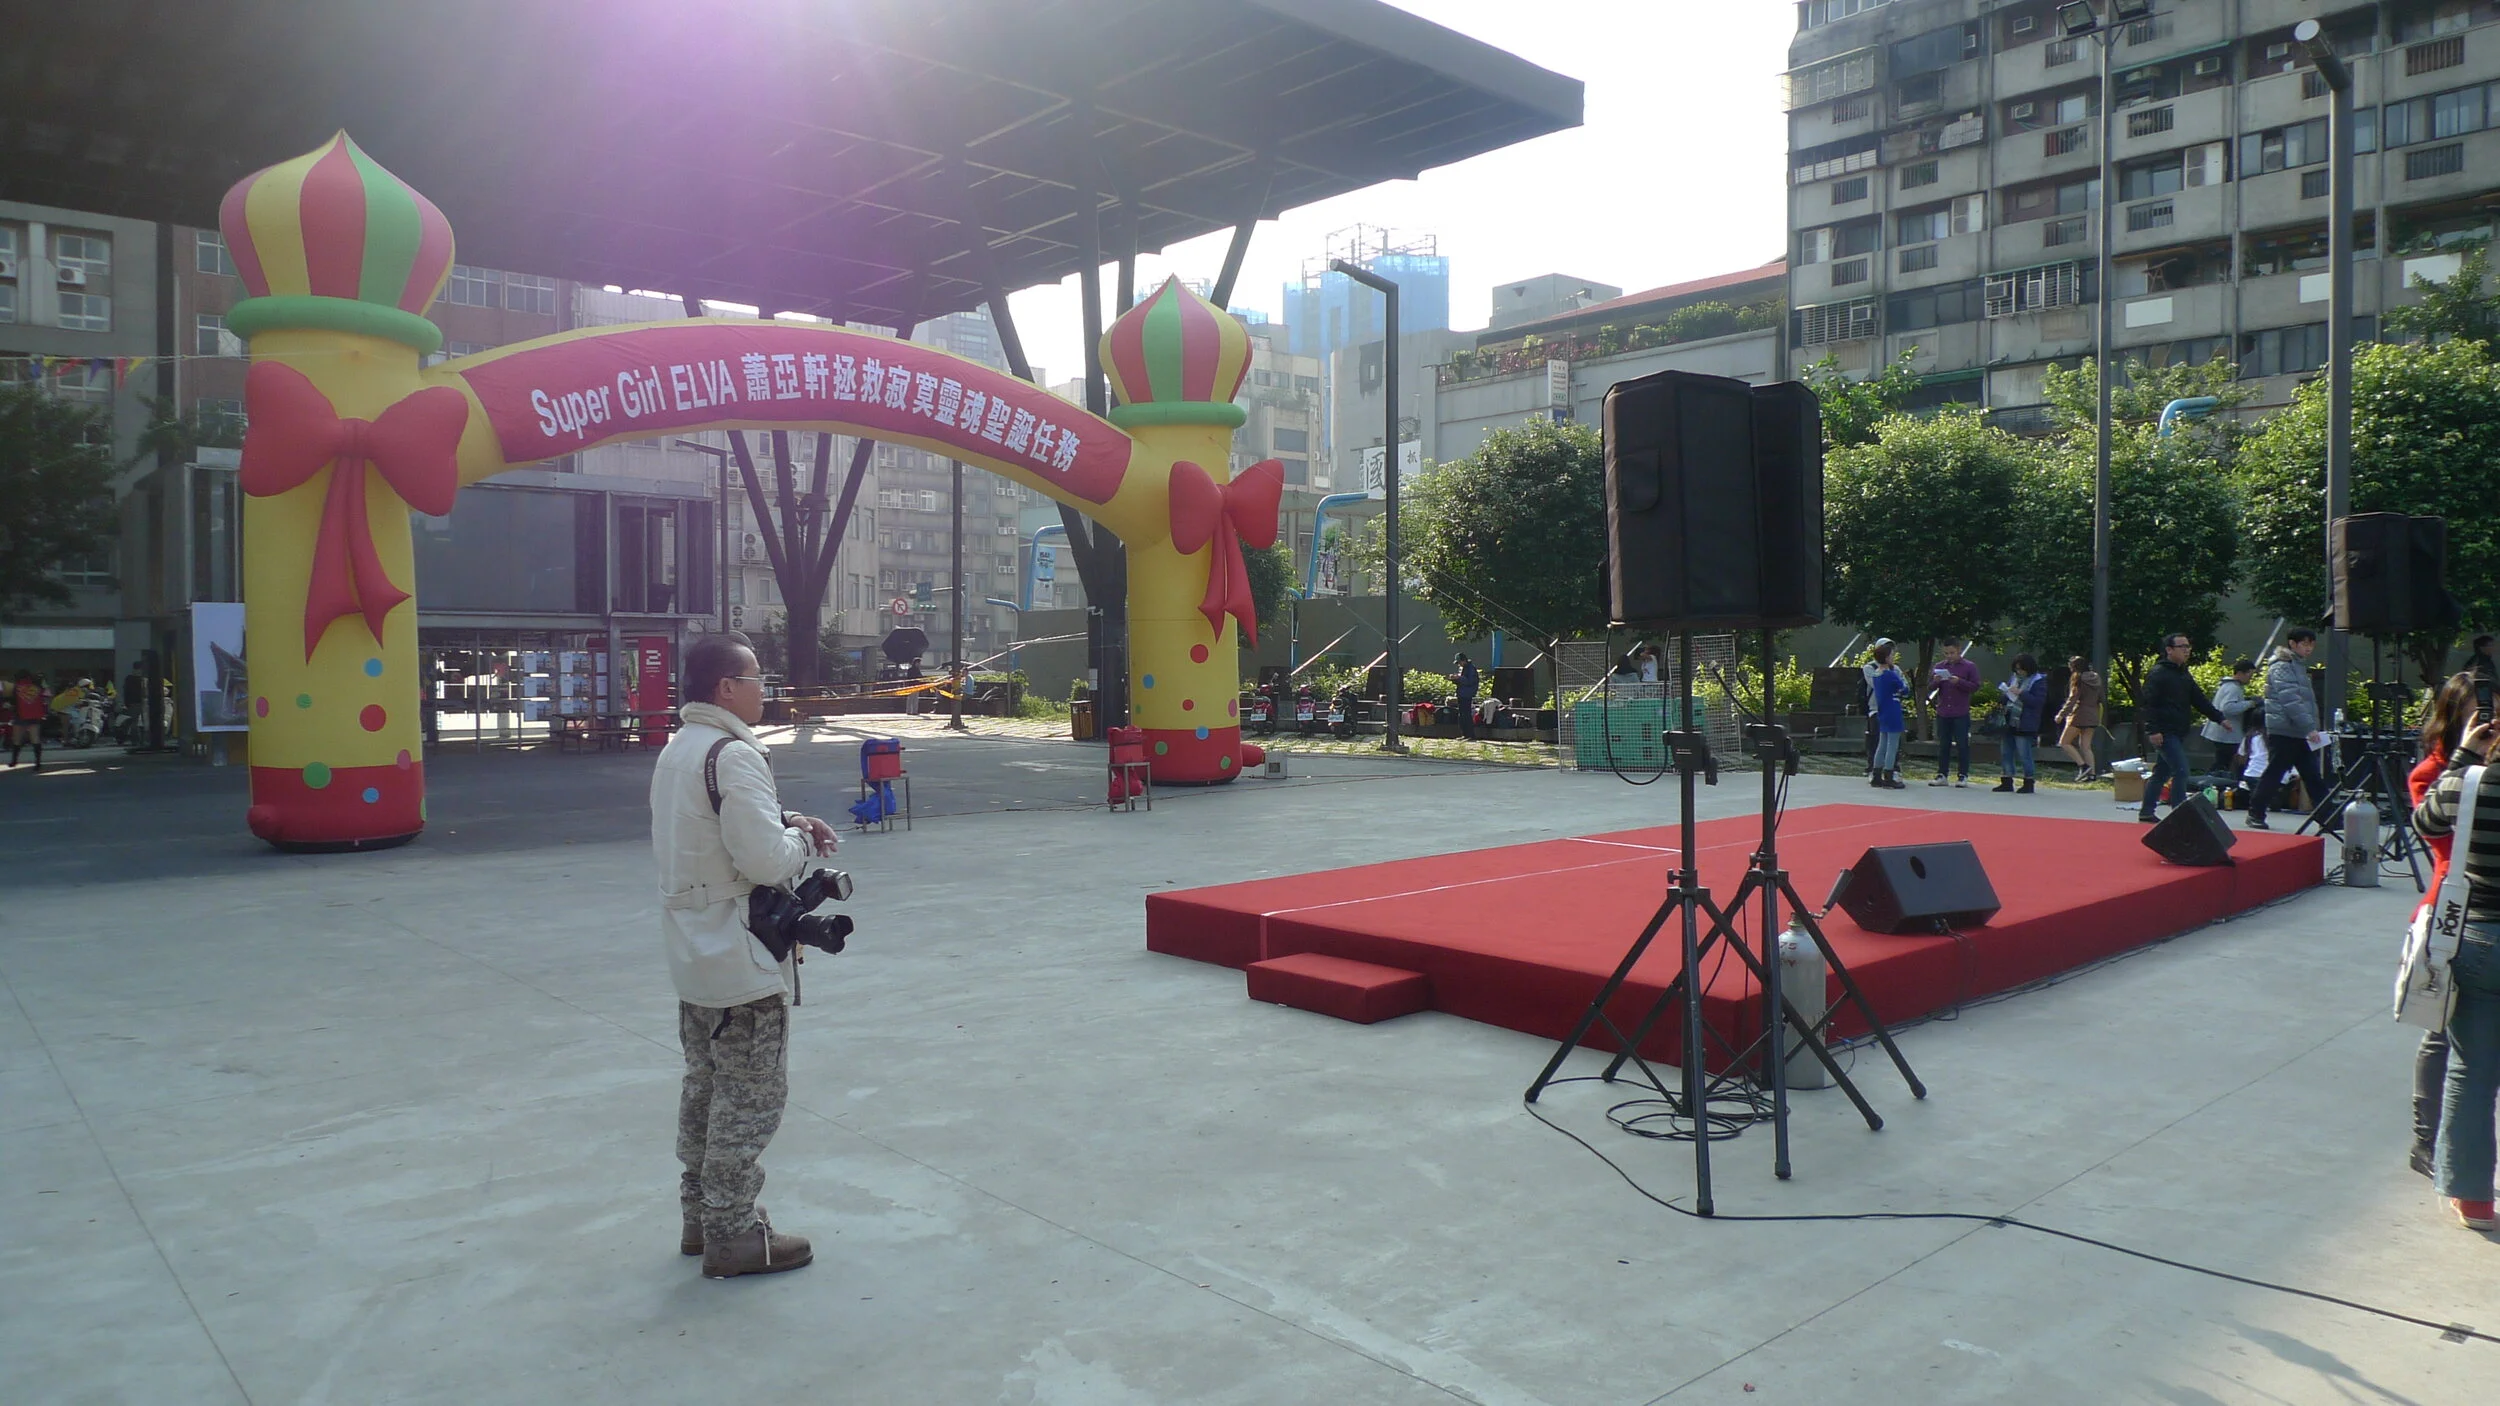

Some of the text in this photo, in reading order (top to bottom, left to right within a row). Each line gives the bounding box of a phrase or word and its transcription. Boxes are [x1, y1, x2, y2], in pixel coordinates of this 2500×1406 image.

[531, 352, 1081, 472] Super Girl ELVA 蕭亞軒拯救寂寞靈魂聖誕任務
[708, 758, 716, 792] Canon
[2441, 899, 2462, 937] PONY
